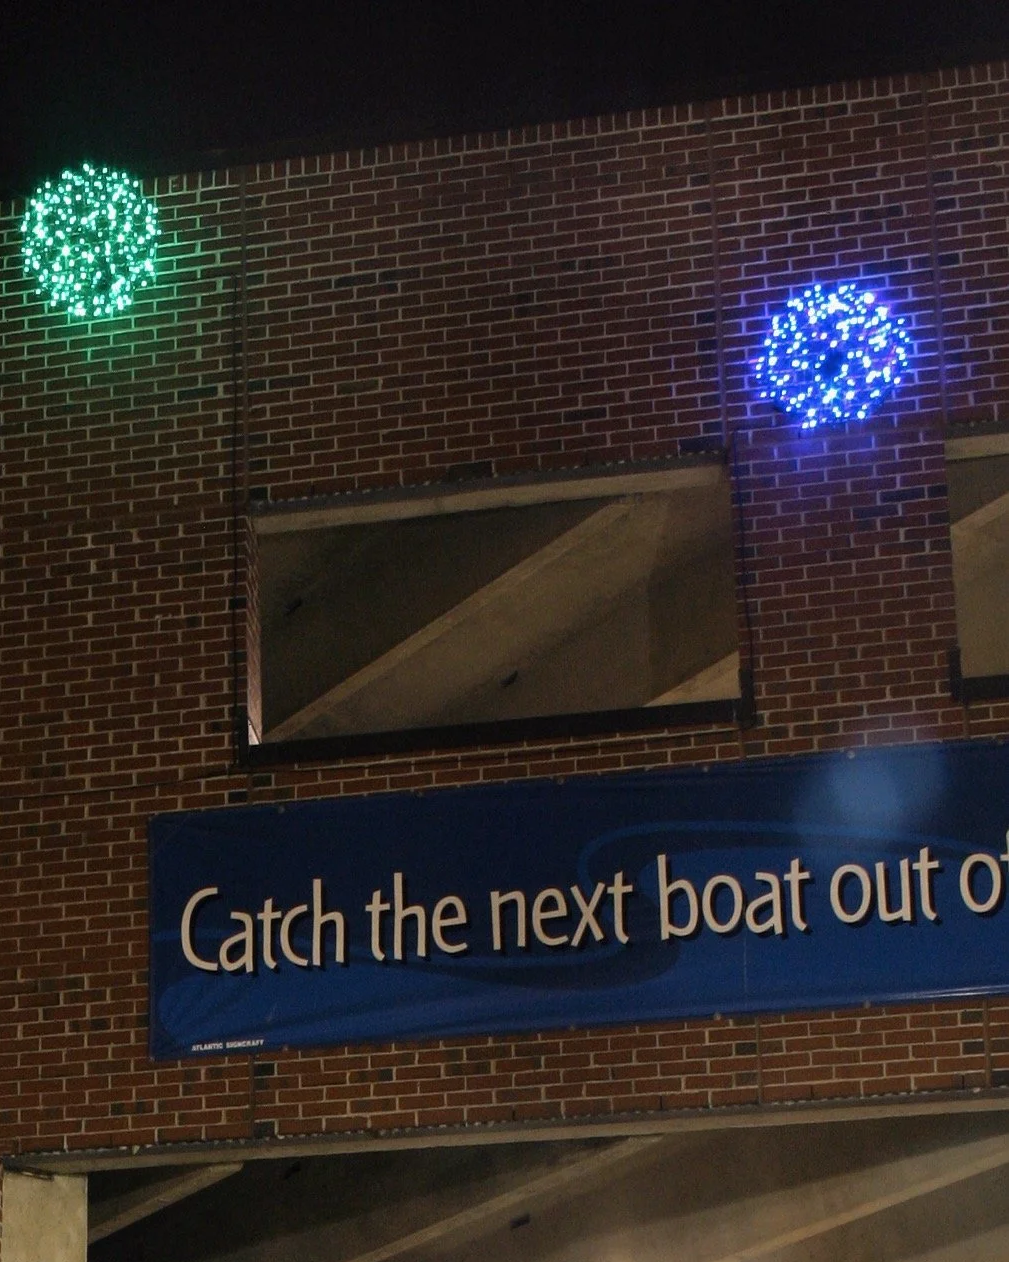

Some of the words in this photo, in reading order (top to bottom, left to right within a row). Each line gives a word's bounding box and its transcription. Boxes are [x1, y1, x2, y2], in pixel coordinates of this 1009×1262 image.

[181, 878, 346, 973] Catch
[366, 872, 467, 961] the
[490, 869, 633, 952] next
[658, 854, 810, 940] boat
[830, 846, 939, 924] out
